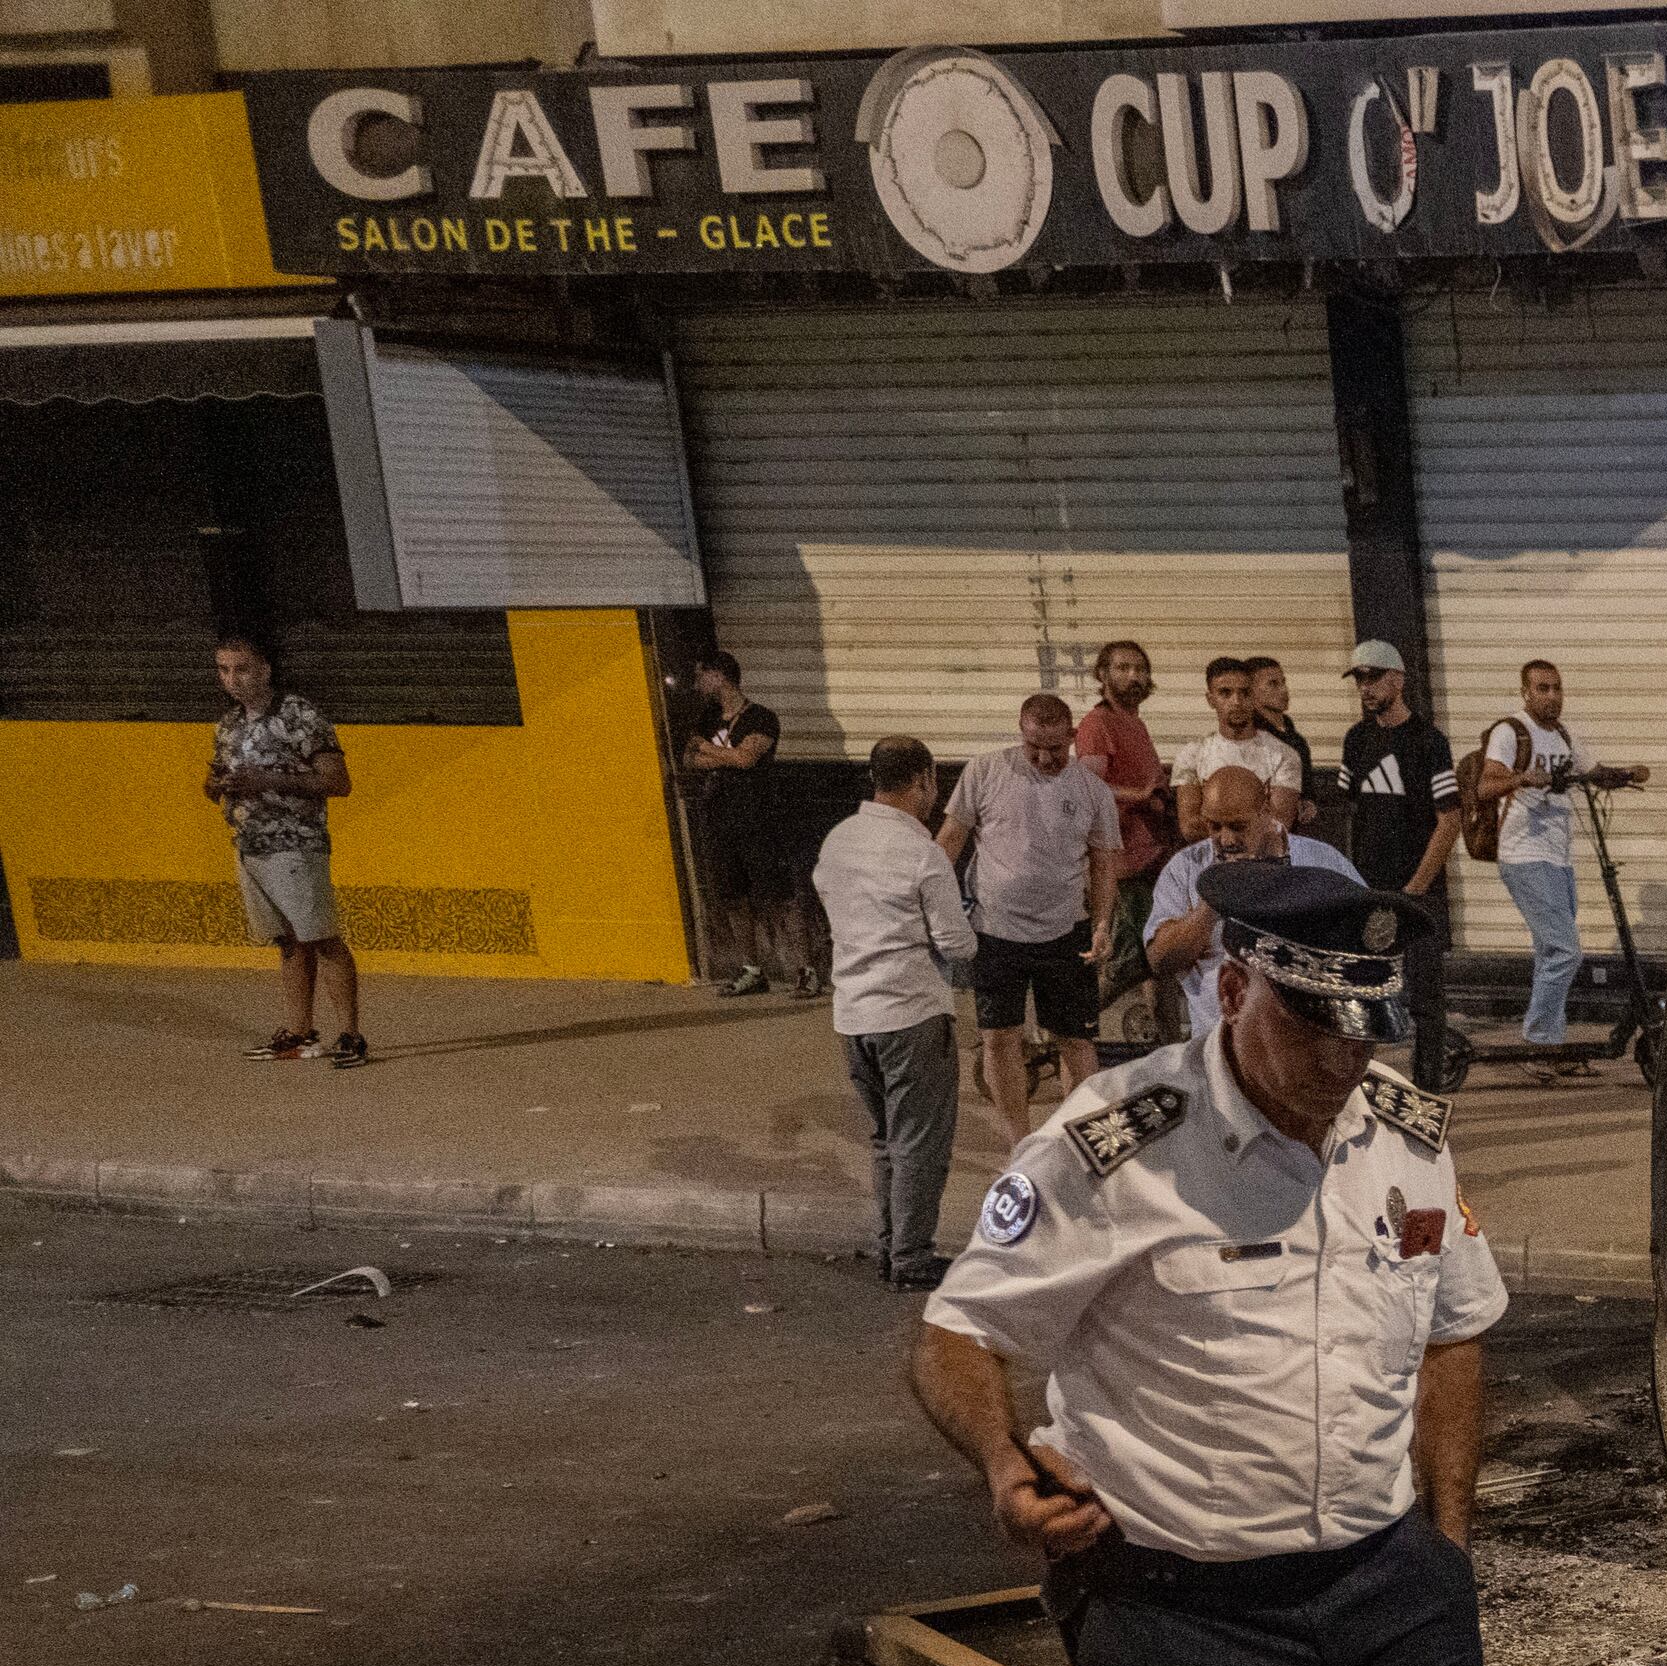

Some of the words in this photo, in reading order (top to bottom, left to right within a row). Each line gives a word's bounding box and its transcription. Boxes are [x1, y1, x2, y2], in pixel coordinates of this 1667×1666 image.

[307, 78, 826, 201] CAFE
[1091, 70, 1308, 238] CUP
[336, 216, 469, 252] SALON
[486, 217, 538, 252] DE
[699, 213, 832, 250] GLACE
